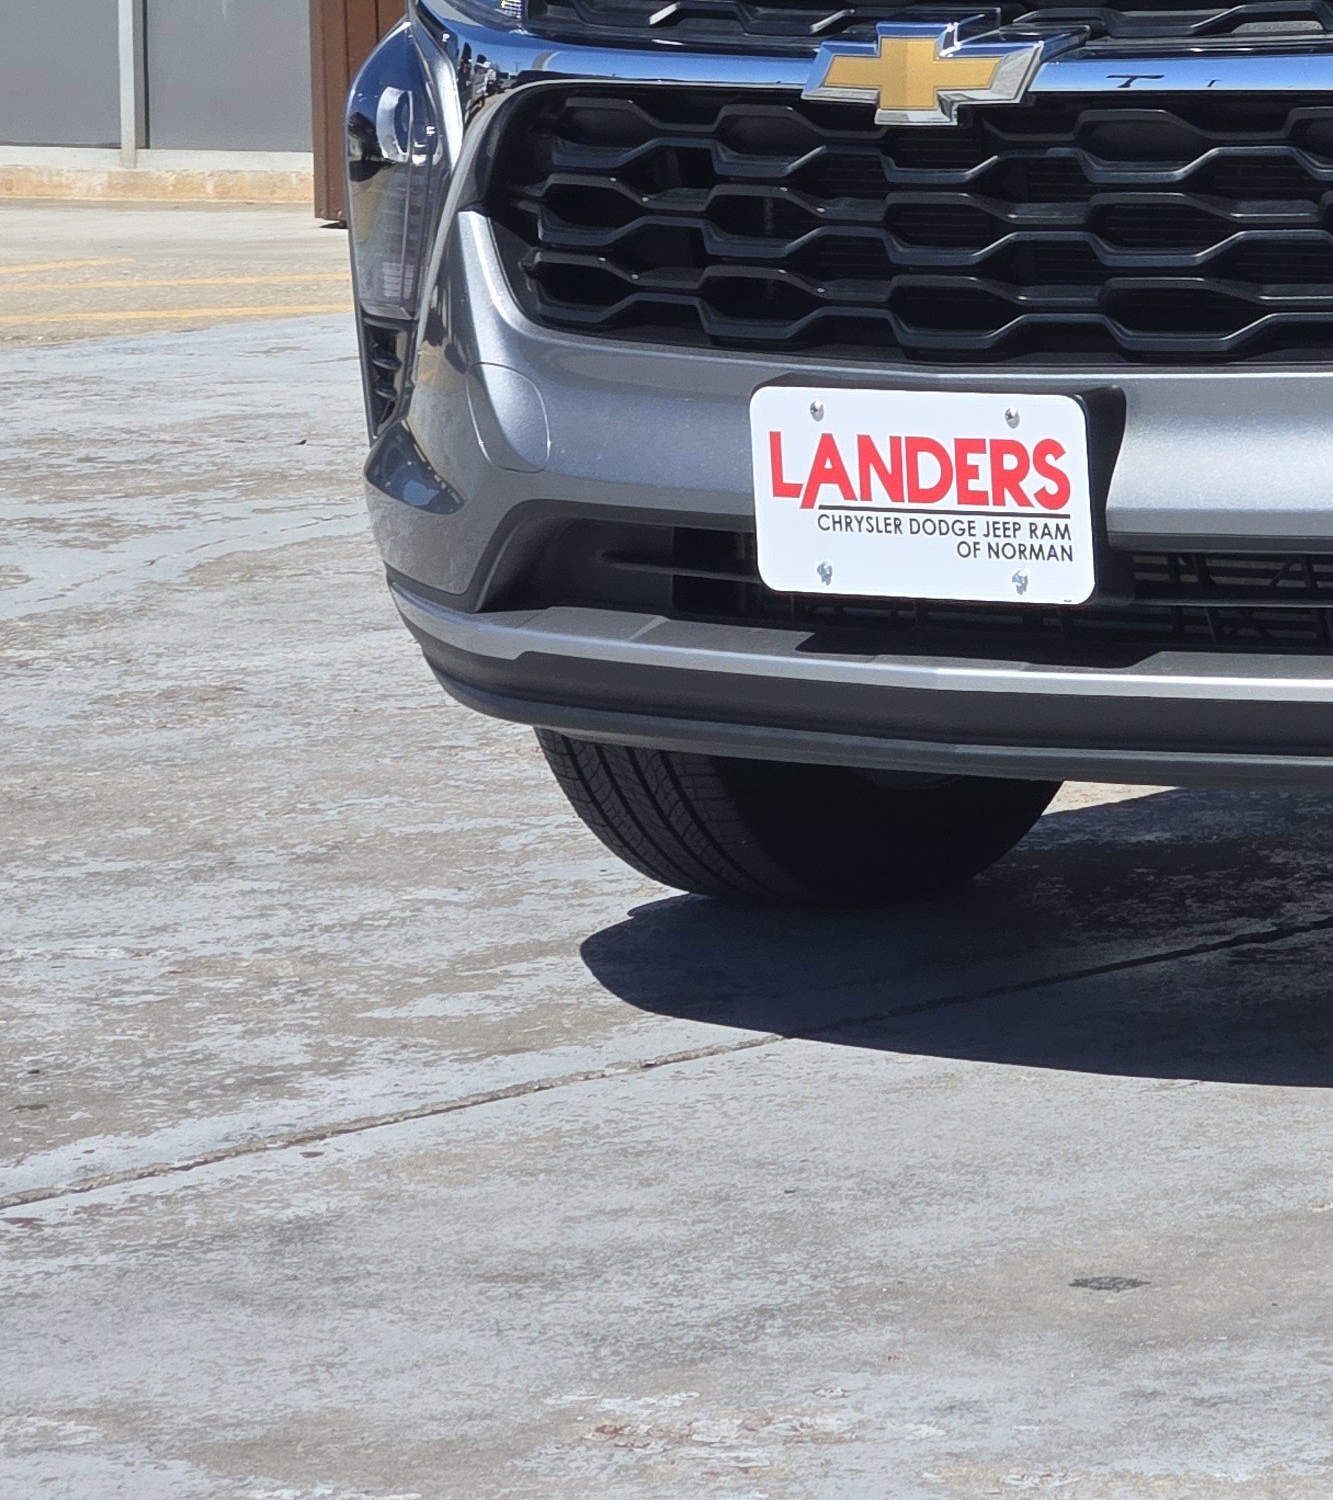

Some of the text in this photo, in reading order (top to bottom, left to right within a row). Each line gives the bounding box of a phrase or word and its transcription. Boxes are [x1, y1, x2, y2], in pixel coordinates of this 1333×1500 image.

[769, 431, 1071, 510] LANDERS
[816, 513, 1073, 542] CHRYSLER DODGE JEEP RAM
[956, 540, 1074, 563] OF NORMAN
